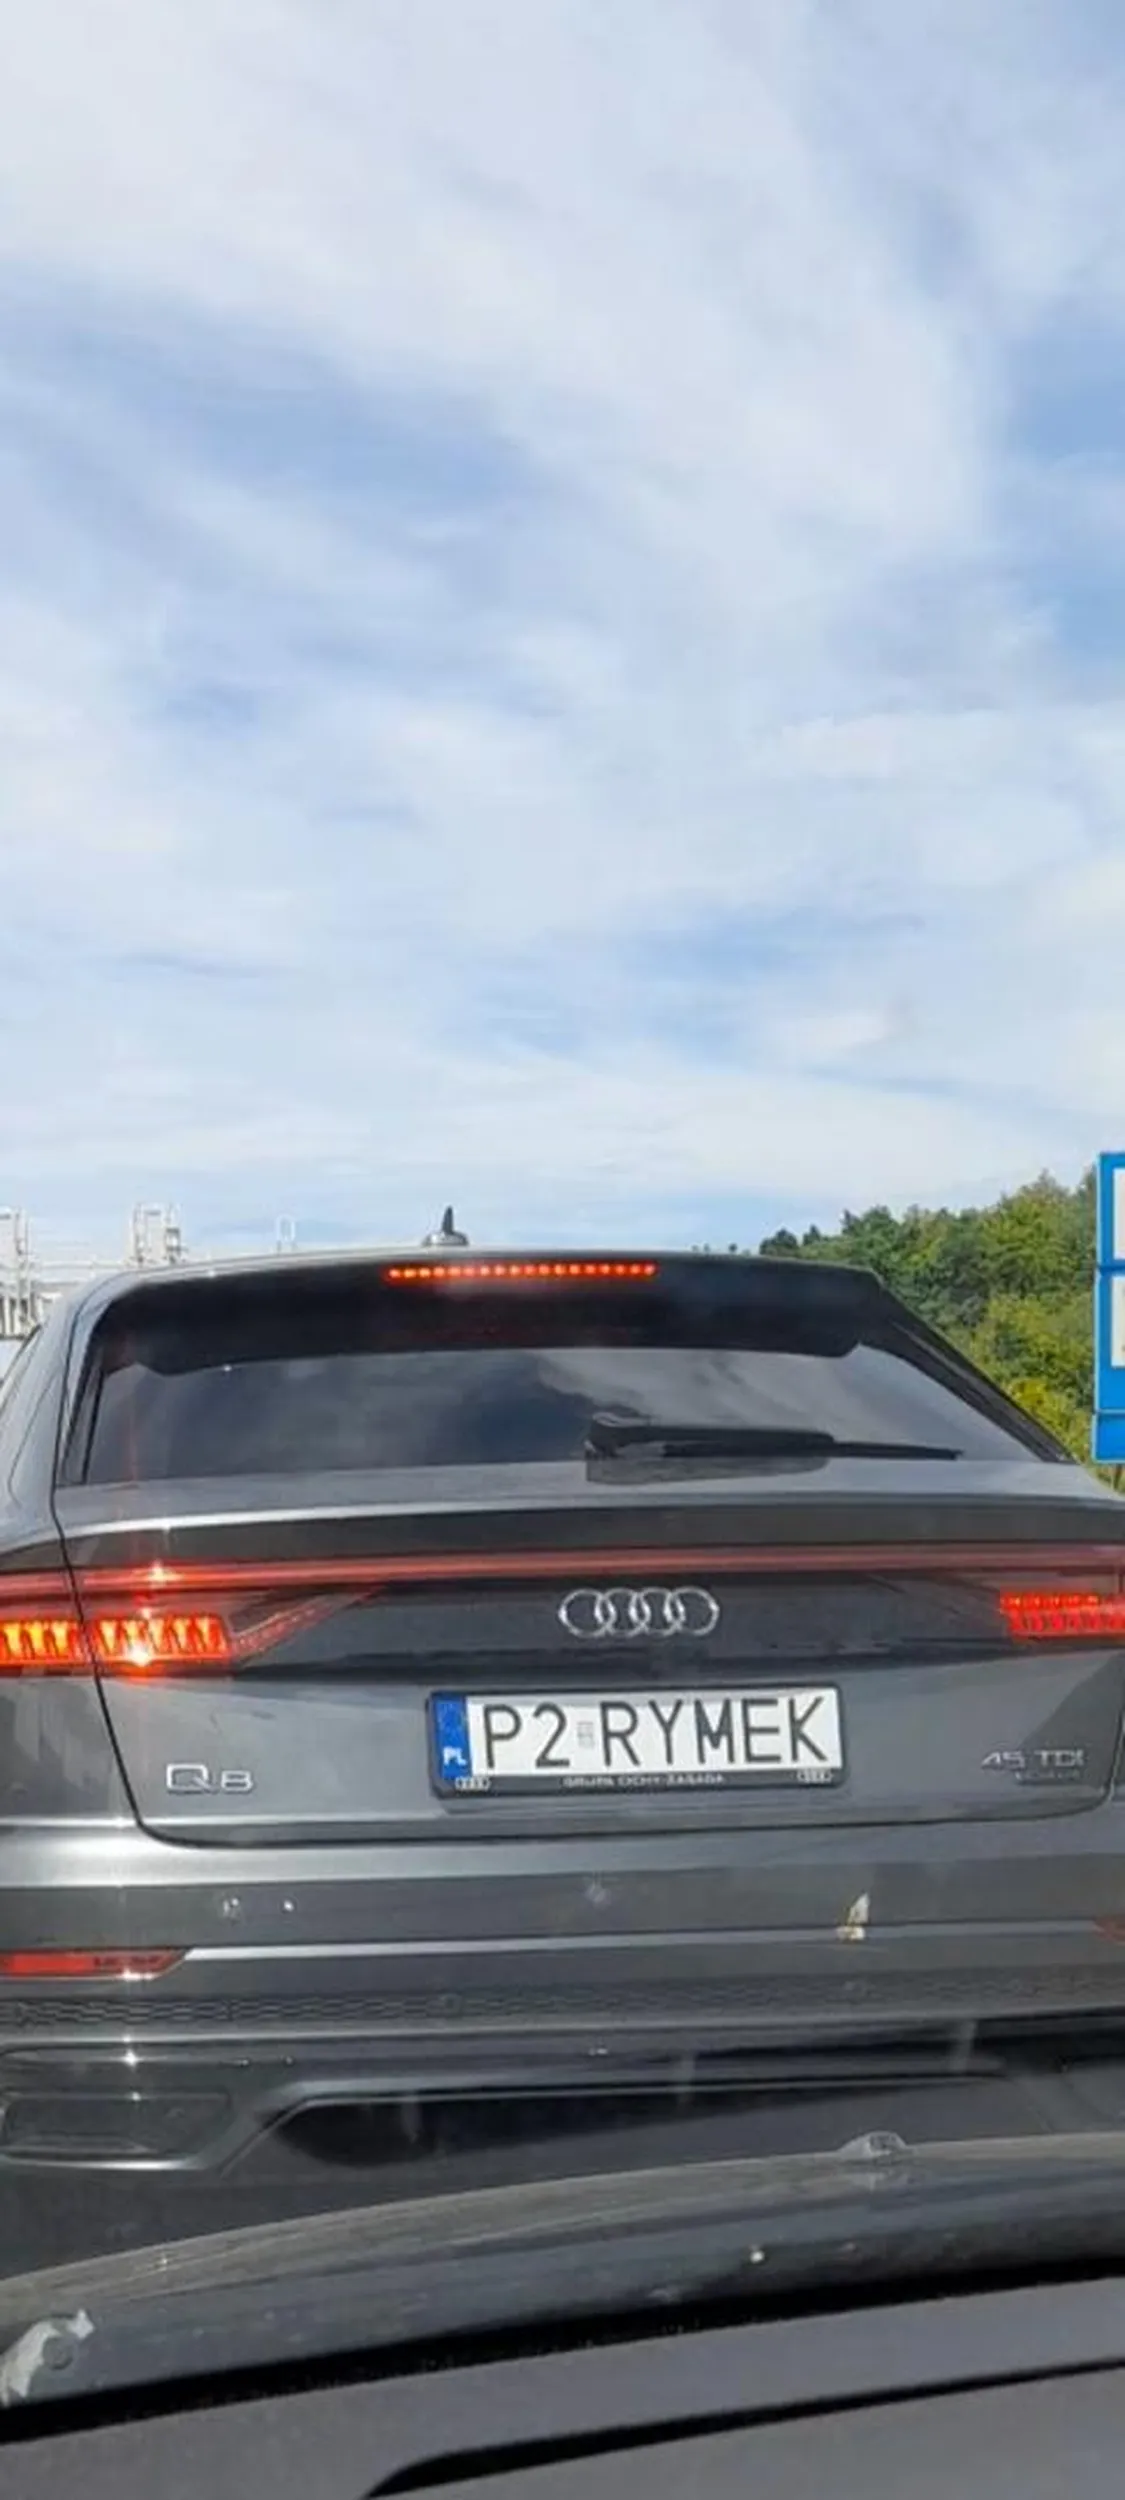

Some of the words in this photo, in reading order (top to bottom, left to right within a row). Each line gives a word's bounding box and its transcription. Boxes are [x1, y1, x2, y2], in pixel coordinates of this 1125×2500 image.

[484, 1702, 571, 1768] P2
[600, 1697, 828, 1766] RYMEK
[443, 1746, 467, 1766] PL
[1034, 1749, 1084, 1767] TDI
[165, 1763, 254, 1794] Q8
